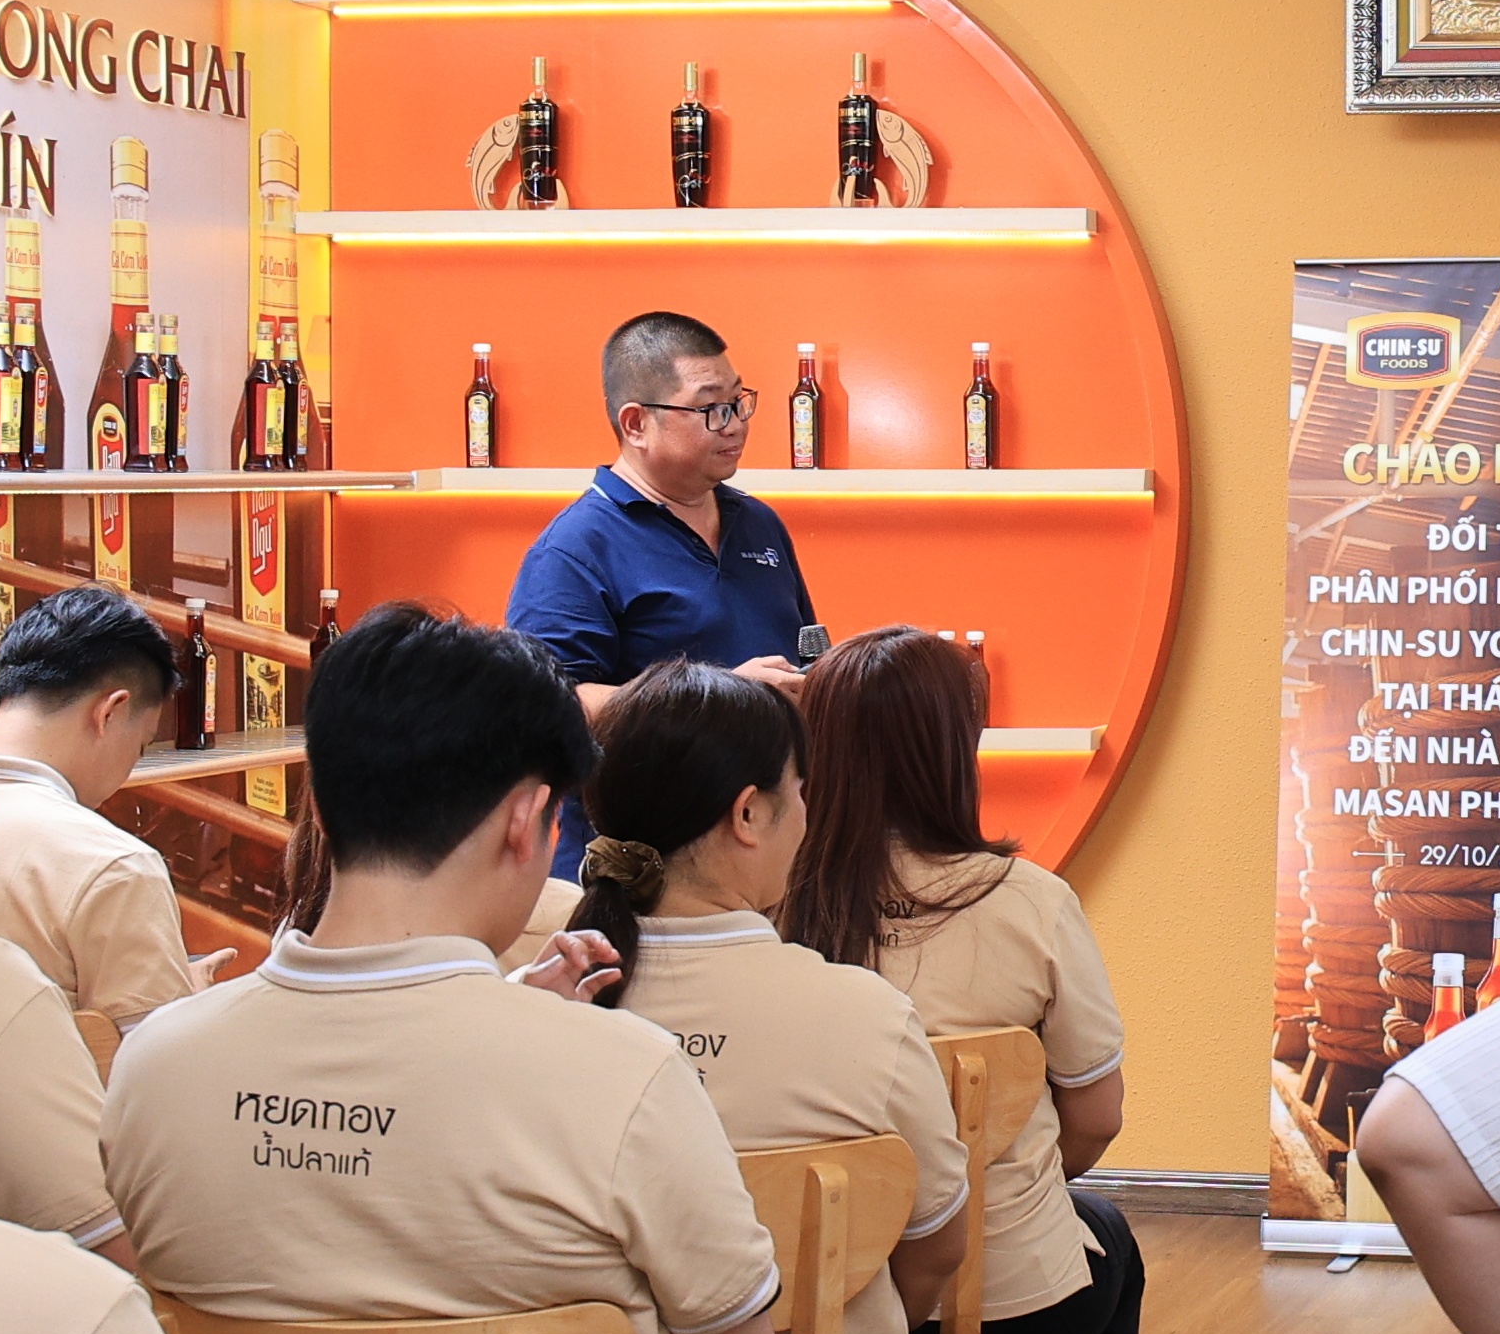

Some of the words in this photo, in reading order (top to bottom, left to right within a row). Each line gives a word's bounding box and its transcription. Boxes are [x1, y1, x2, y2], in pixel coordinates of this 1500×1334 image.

[126, 27, 250, 120] CHAI
[1365, 337, 1441, 357] CHIN-SU
[1380, 359, 1429, 370] FOODS
[1342, 431, 1481, 485] CHÀO
[1427, 515, 1486, 552] ĐỐI
[1308, 570, 1398, 605] PHÂN
[1407, 569, 1487, 605] PHỐI
[1321, 628, 1460, 657] CHIN-SU
[1379, 682, 1429, 718] TẠI
[1347, 728, 1417, 764] ĐẾN
[1427, 729, 1499, 765] NHÀ
[1334, 788, 1450, 818] MASAN
[234, 1085, 396, 1139] หยดทอง
[253, 1131, 373, 1178] น้ำปลาแท้
